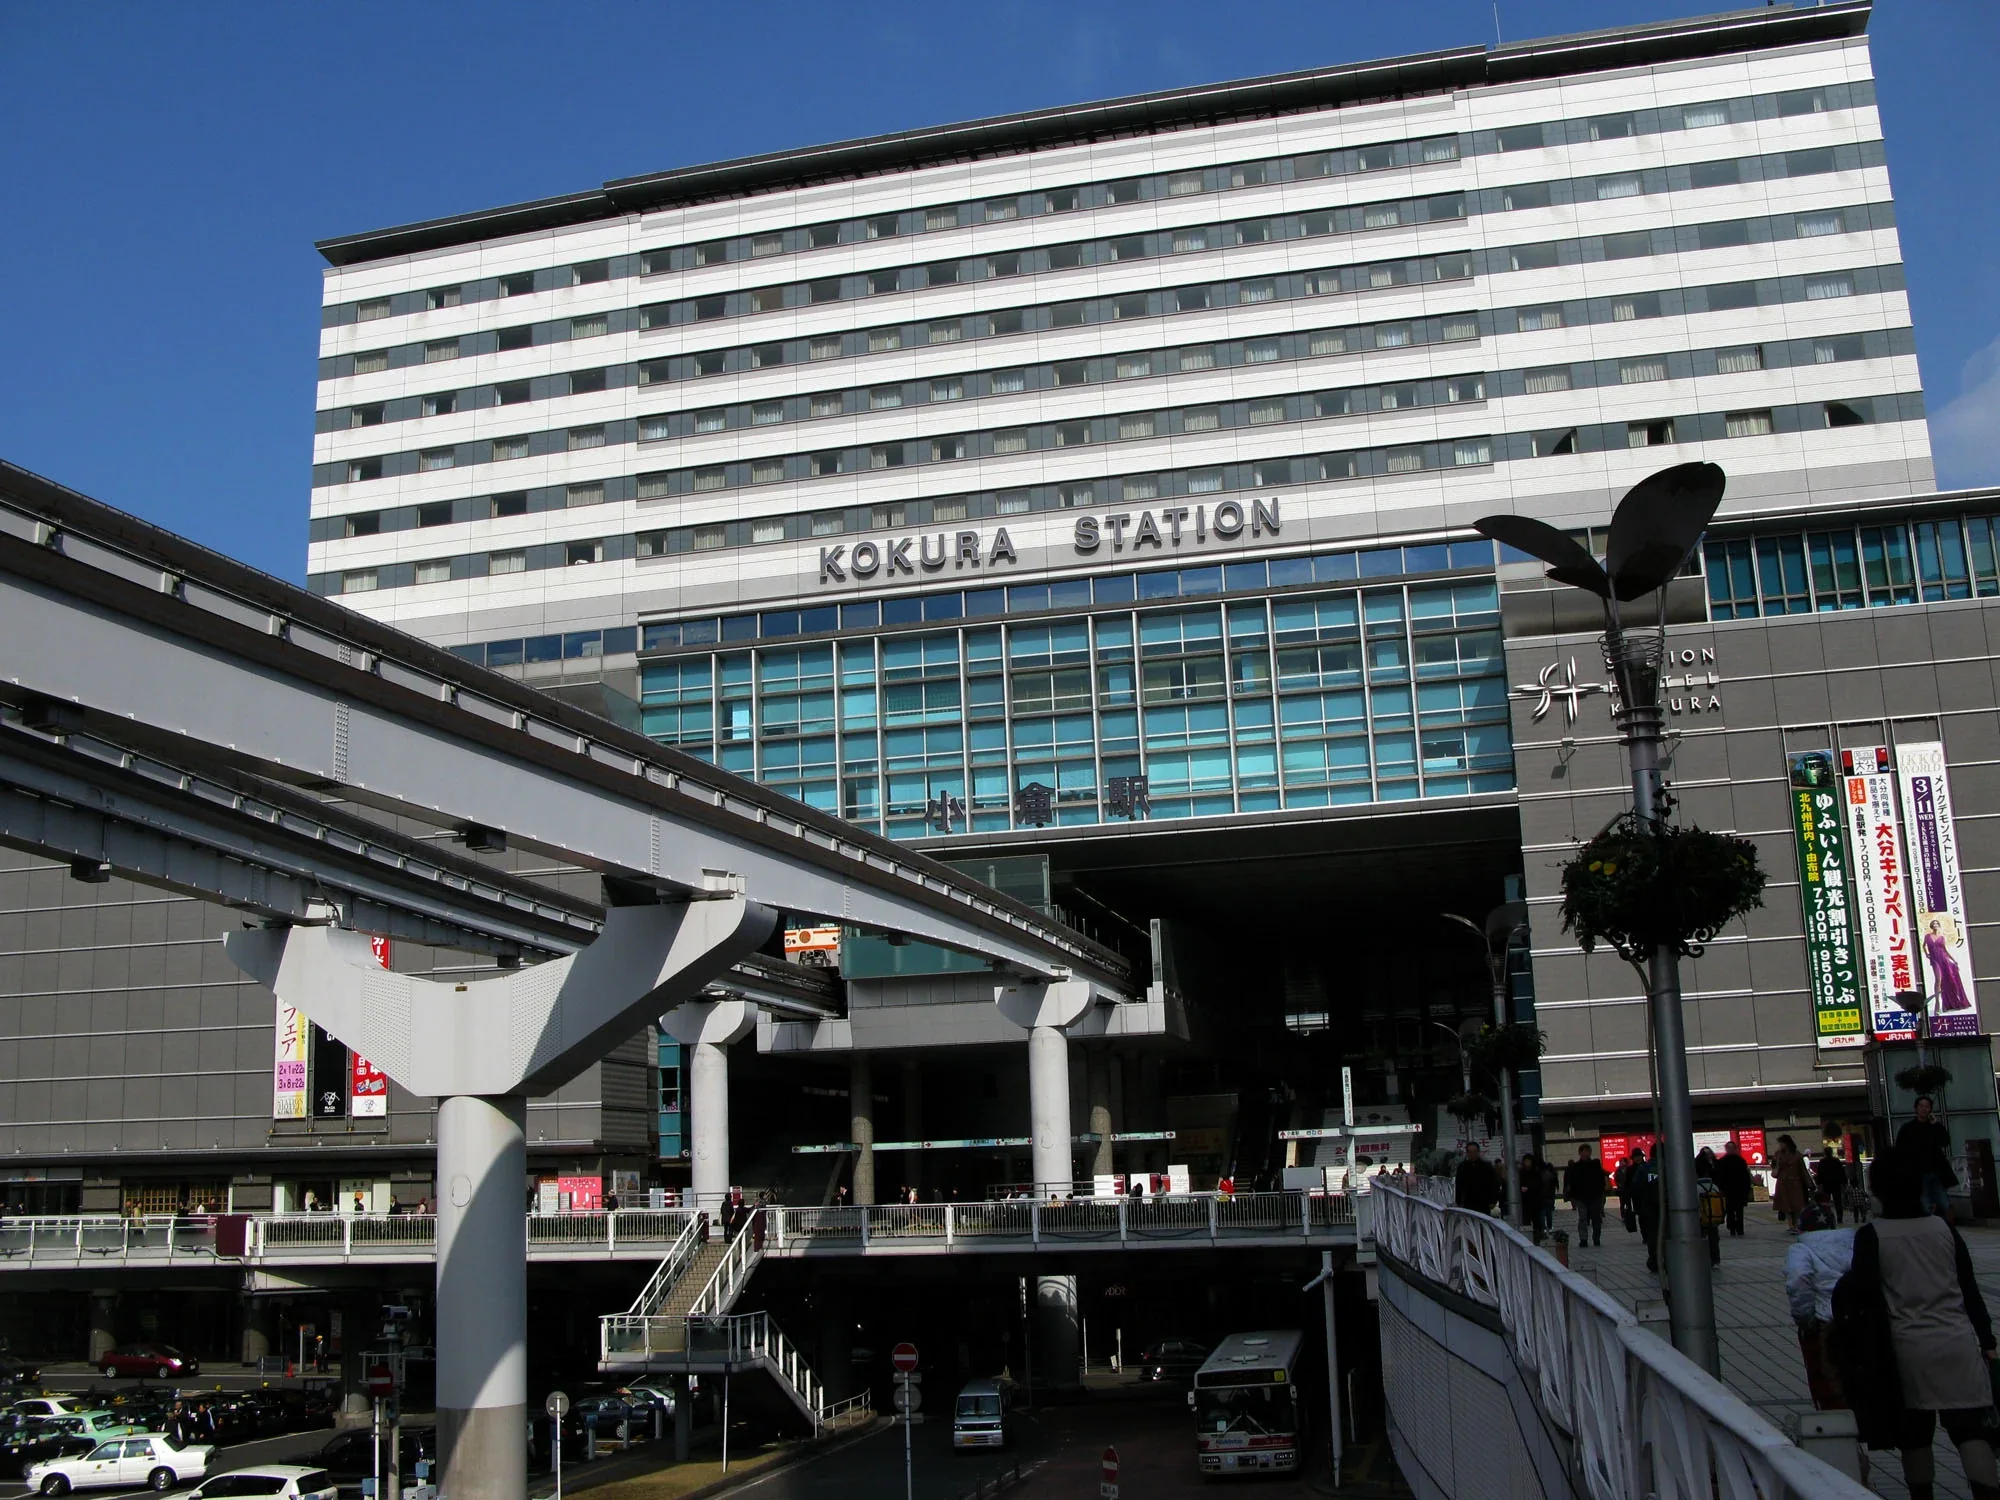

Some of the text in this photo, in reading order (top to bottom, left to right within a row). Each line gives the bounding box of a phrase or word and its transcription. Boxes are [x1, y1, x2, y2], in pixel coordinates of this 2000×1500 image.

[818, 497, 1281, 581] KOKURA STATION
[1608, 671, 1715, 694] HTEL
[1610, 695, 1721, 716] KURA
[1915, 779, 1933, 814] 3/11
[1935, 775, 1959, 904] メイクデモンストレーション
[1954, 919, 1964, 948] トーク
[1815, 793, 1856, 1005] ゆふいん観光割引きっぷ
[1875, 823, 1911, 992] 大分キャンペーン実施
[281, 1007, 297, 1057] フェア
[1829, 1036, 1855, 1045] JR九州
[1885, 1032, 1912, 1041] JR九州
